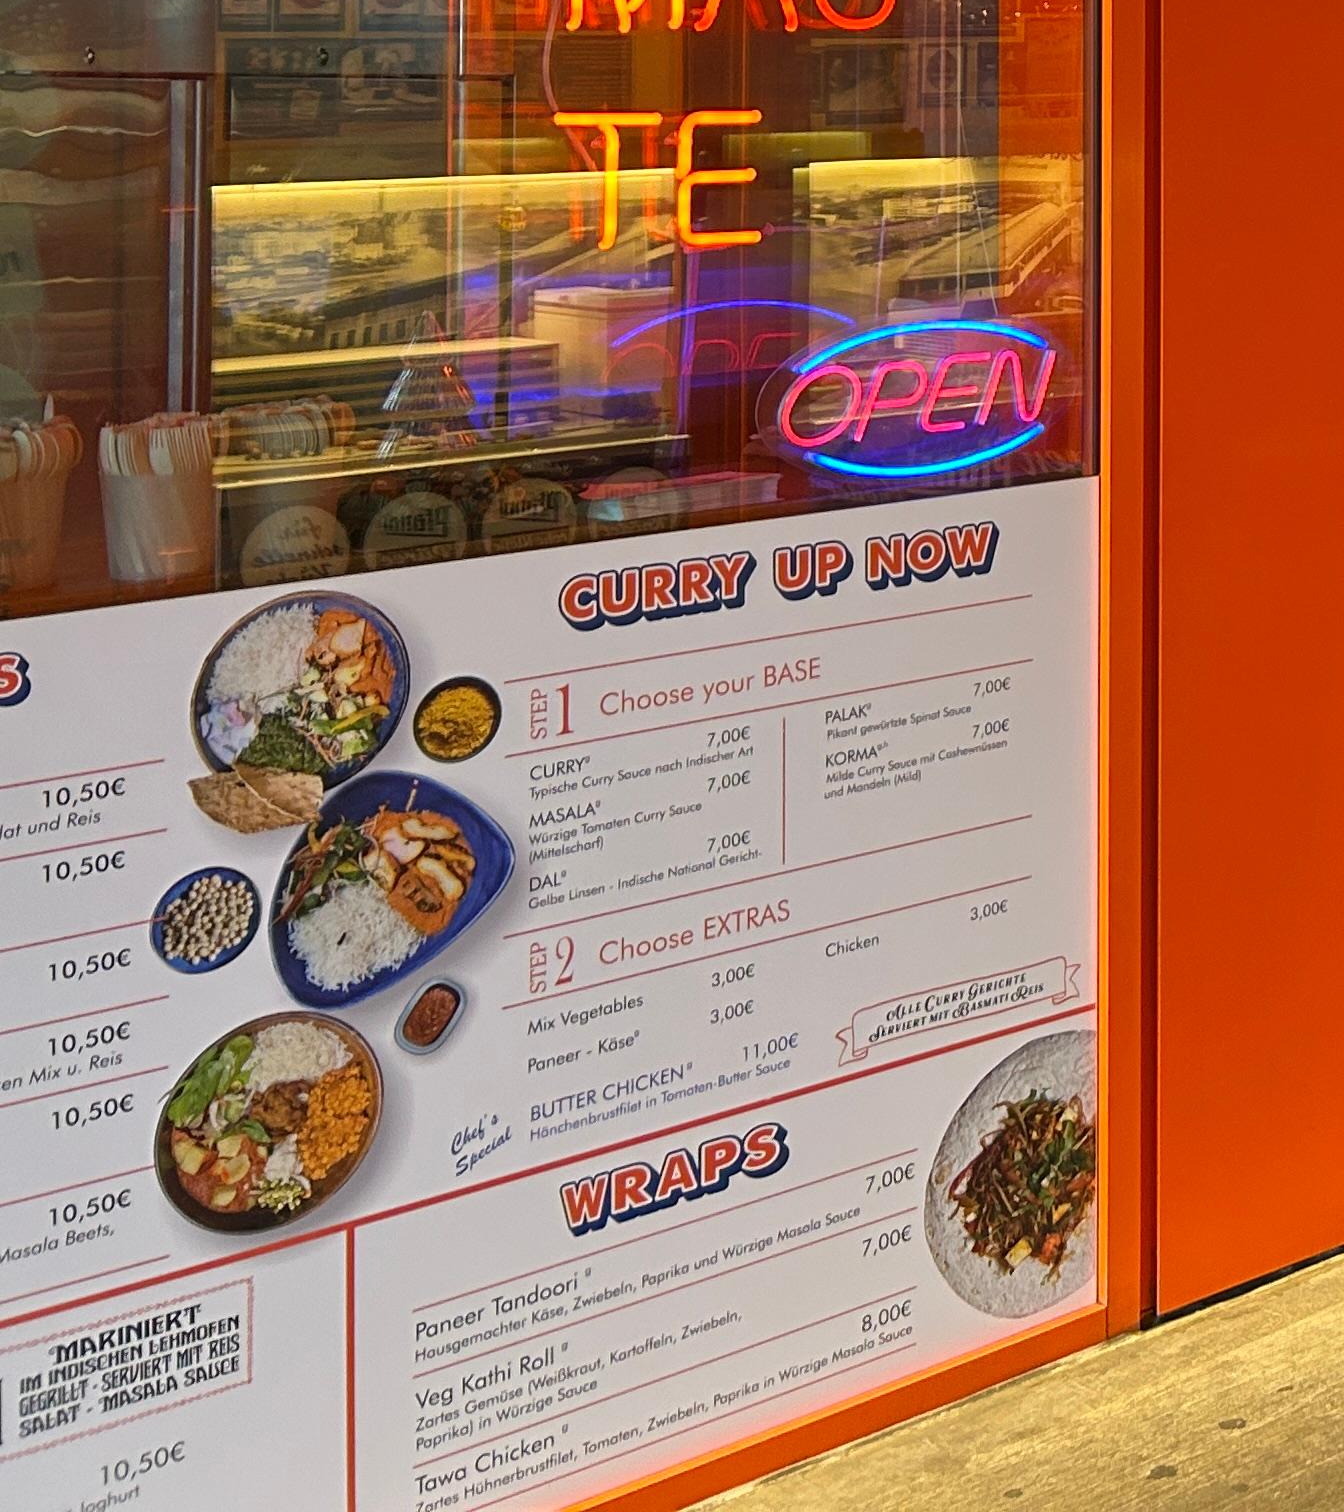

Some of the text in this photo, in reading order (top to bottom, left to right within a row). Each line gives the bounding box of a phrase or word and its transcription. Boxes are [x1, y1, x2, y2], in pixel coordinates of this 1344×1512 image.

[551, 108, 763, 251] TE
[781, 349, 1058, 448] OPEN
[560, 521, 1000, 632] CURRY UP NOW
[530, 656, 822, 740] STEP 1 Choose your BASE
[973, 676, 1012, 698] 7,00€
[707, 725, 752, 749] 7,00€
[827, 704, 972, 740] Pikant Spinat Sauce
[972, 717, 1011, 739] 7,00€
[529, 749, 735, 801] Typische Curry Sauce nach Indischer
[707, 770, 751, 793] 7,00€
[824, 776, 892, 800] und Mandeln
[826, 769, 855, 784] Milde
[857, 764, 886, 778] Curry
[888, 757, 918, 772] Sauce
[42, 777, 127, 809] 10,50€
[27, 810, 102, 836] und Reis
[528, 802, 703, 848] Würzige Tomaten Curry Sauce
[707, 830, 751, 854] 7,00€
[42, 850, 126, 883] 10,50€
[528, 859, 717, 911] Gelbe Linsen Indische National
[968, 899, 1010, 923] 3,00€
[47, 947, 133, 983] 10,50€
[530, 898, 791, 994] STEP 2 Choose EXTRAS
[824, 936, 880, 958] Chicken
[711, 962, 756, 988] 3,00€
[526, 994, 644, 1036] Mix Vegetables
[710, 999, 755, 1025] 3,00€
[48, 1021, 132, 1057] 10,50€
[741, 1032, 800, 1064] 11,00€
[28, 1050, 124, 1086] Mix Reis
[527, 1047, 582, 1074] Paneer
[52, 1093, 135, 1131] 10,50€
[529, 1100, 643, 1143] Hänchenbrustfilet
[754, 1058, 792, 1078] Sauce
[530, 1089, 598, 1123] BUTTER
[454, 1125, 514, 1178] Special
[559, 1121, 791, 1239] WRAPS
[864, 1161, 917, 1196] 7,00€
[49, 1188, 132, 1227] 10,50€
[861, 1223, 914, 1258] 7,00€
[414, 1205, 862, 1364] Hausgemachter Zwiebeln, Paprika und Würzige Masala Sauce
[414, 1271, 580, 1343] Paneer Tandoori
[861, 1299, 913, 1333] 8,00€
[49, 1343, 144, 1386] INDISCHEN
[101, 1353, 173, 1392] SERVIERT
[415, 1310, 744, 1434] Zartes Gemüse Kartoffeln, Zwiebeln,
[415, 1345, 555, 1410] Veg Kathi Roll
[18, 1355, 241, 1440] SALAT MASALA SAUCE
[415, 1379, 599, 1452] Paprika) Würzige Sauce
[463, 1324, 914, 1501] Hühnerbrustfilet, Tomaten, Zwiebeln, Paprika Würzige Masala Sauce
[100, 1439, 187, 1486] 10,50€
[414, 1434, 556, 1496] Tawa Chicken
